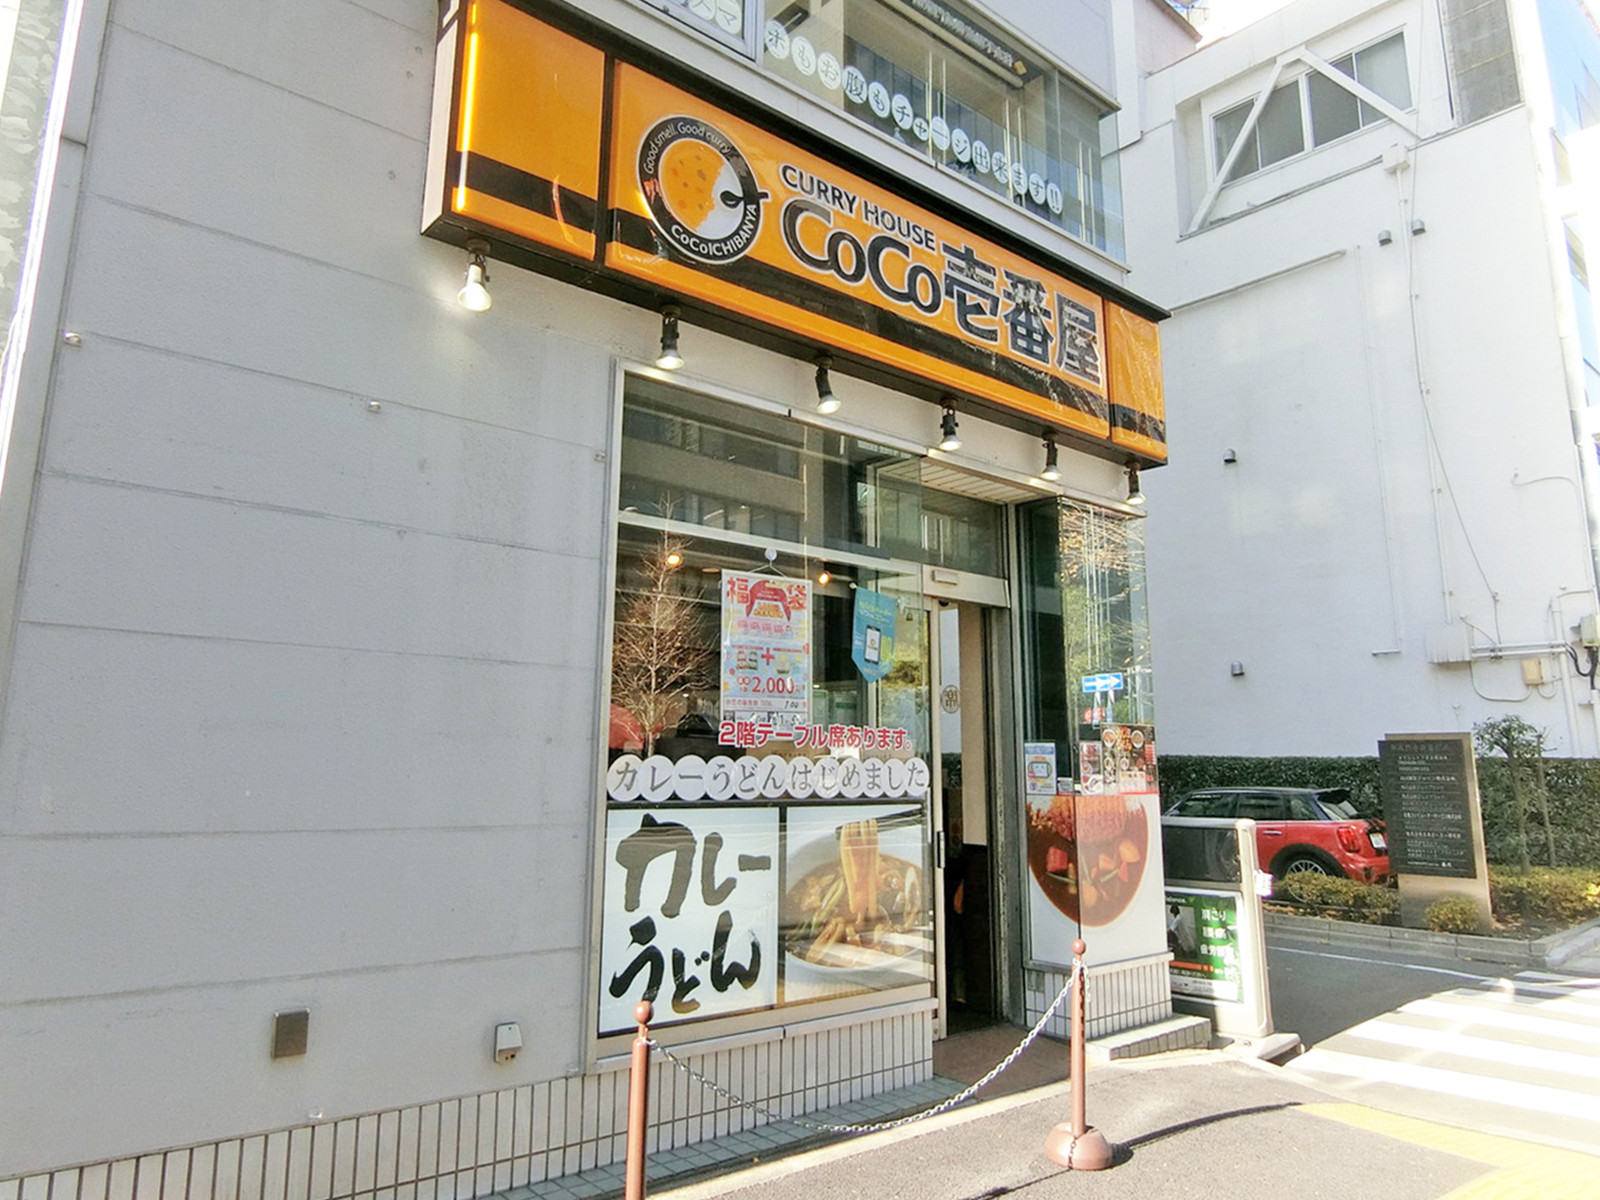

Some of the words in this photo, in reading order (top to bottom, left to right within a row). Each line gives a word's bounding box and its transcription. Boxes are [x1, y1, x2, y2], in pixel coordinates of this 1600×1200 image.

[677, 121, 706, 137] Good
[781, 164, 857, 214] CURRY
[864, 200, 936, 251] HOUSE
[719, 722, 912, 750] 2階テーブル席あります。
[612, 761, 925, 795] カレーうどんはじめました
[615, 813, 771, 919] カレー
[609, 910, 761, 1014] うどん
